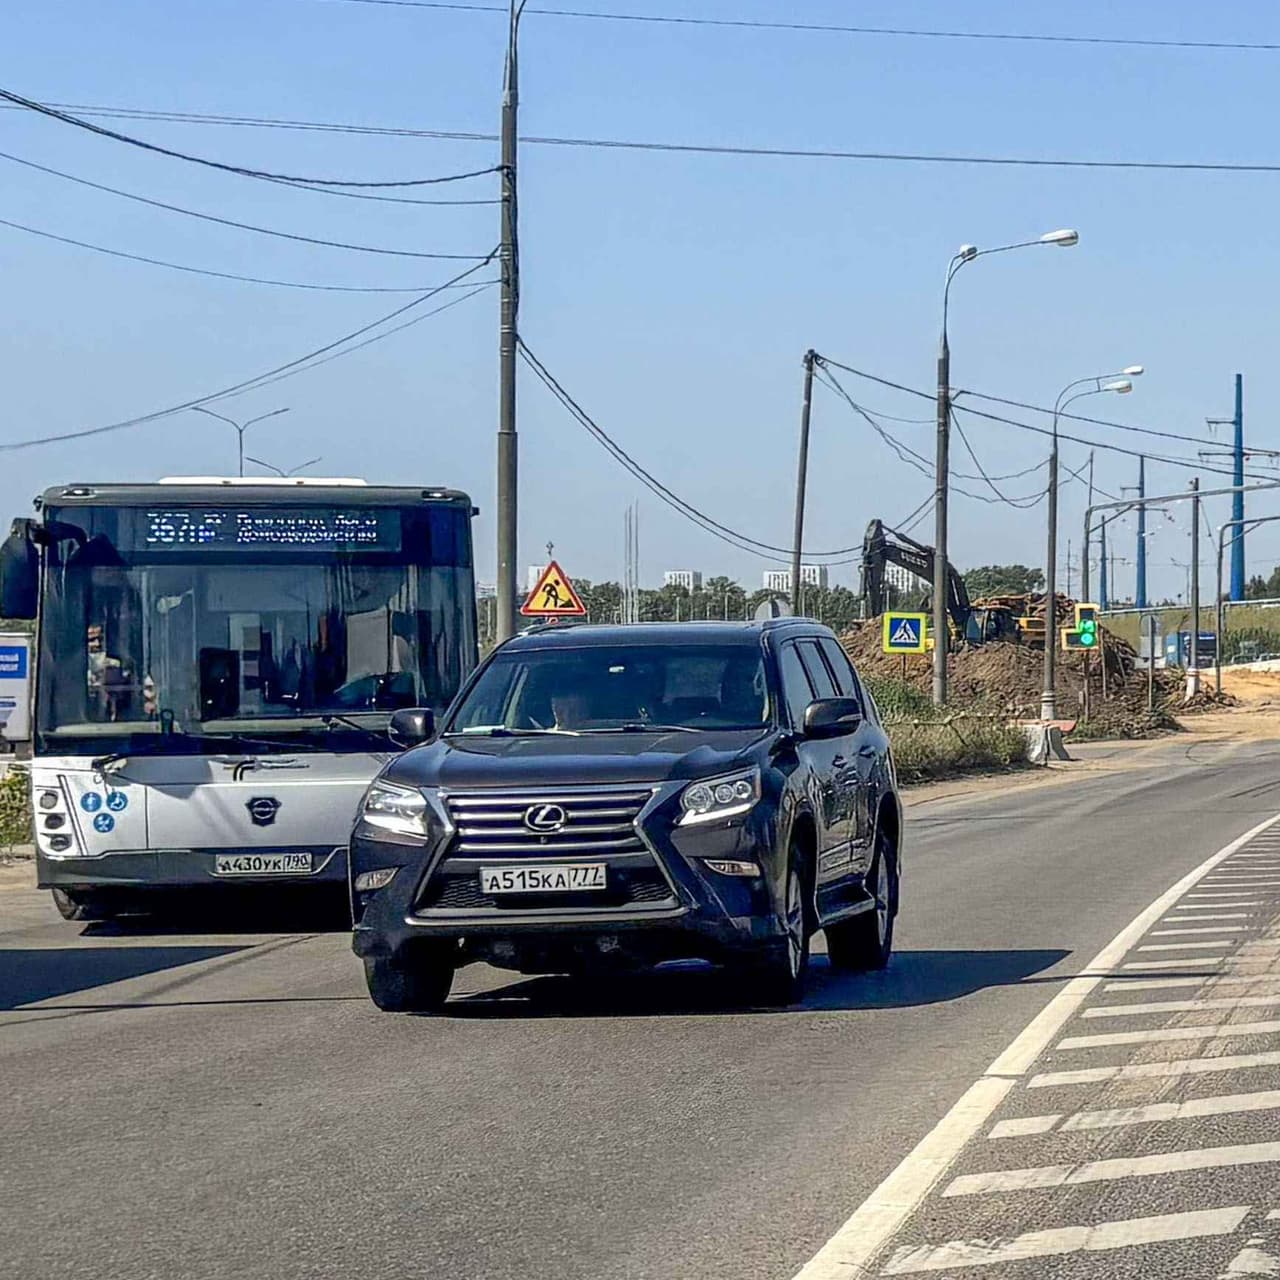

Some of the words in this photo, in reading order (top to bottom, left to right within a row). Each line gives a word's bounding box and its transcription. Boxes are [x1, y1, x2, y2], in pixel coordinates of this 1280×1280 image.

[221, 856, 281, 871] А430УК
[489, 871, 566, 890] А515КА
[571, 867, 600, 882] 777
